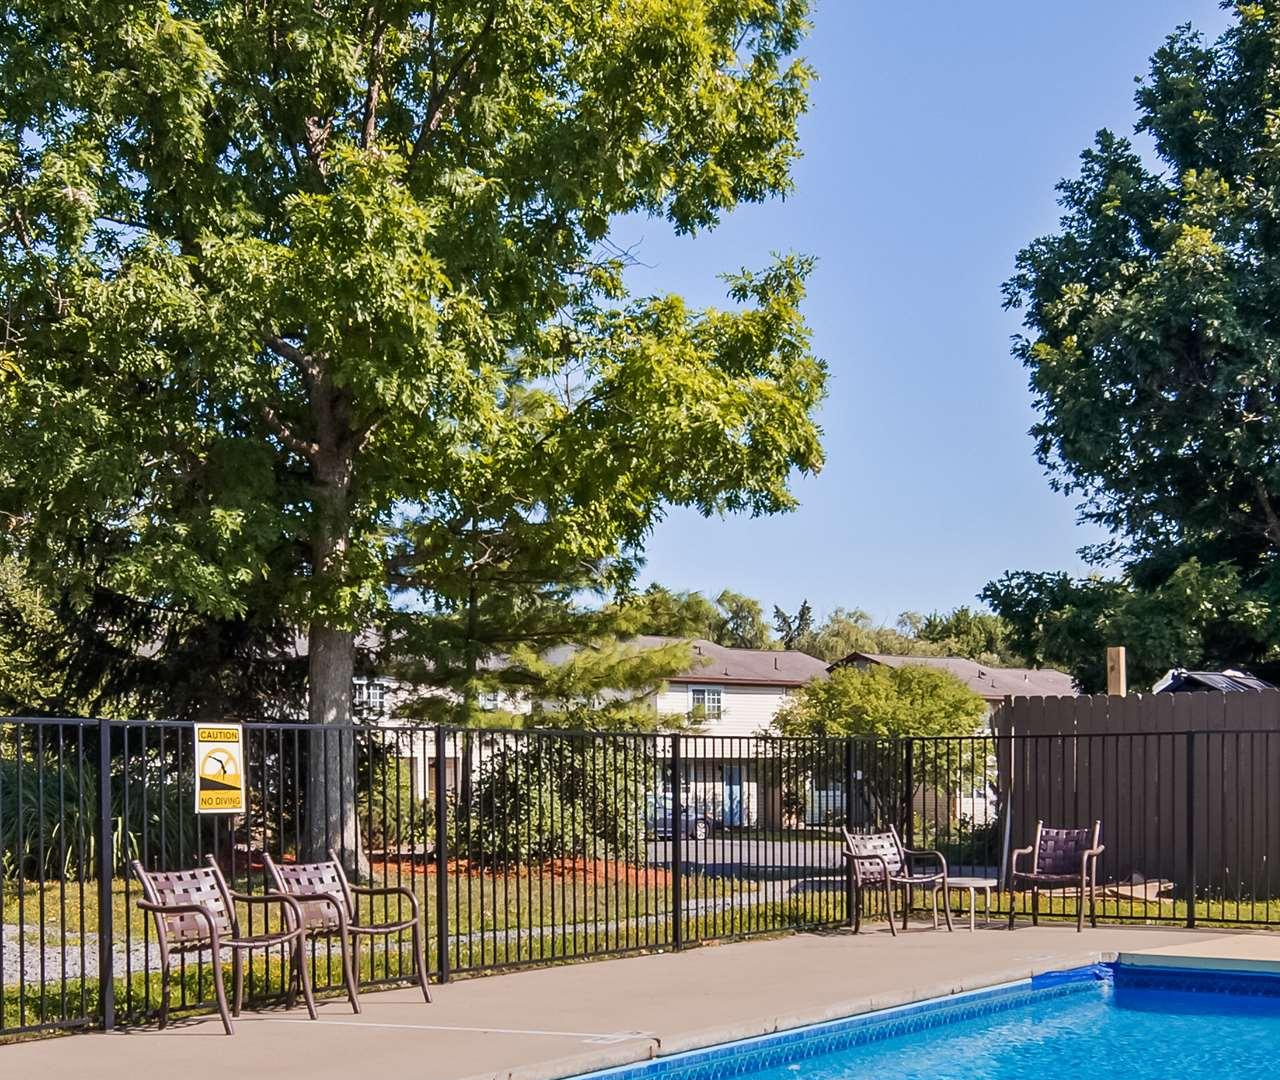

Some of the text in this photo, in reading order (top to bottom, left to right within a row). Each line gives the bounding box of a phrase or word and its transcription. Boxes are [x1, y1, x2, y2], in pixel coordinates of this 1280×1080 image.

[200, 731, 237, 740] CAUTION
[201, 797, 240, 806] NO DIVING
